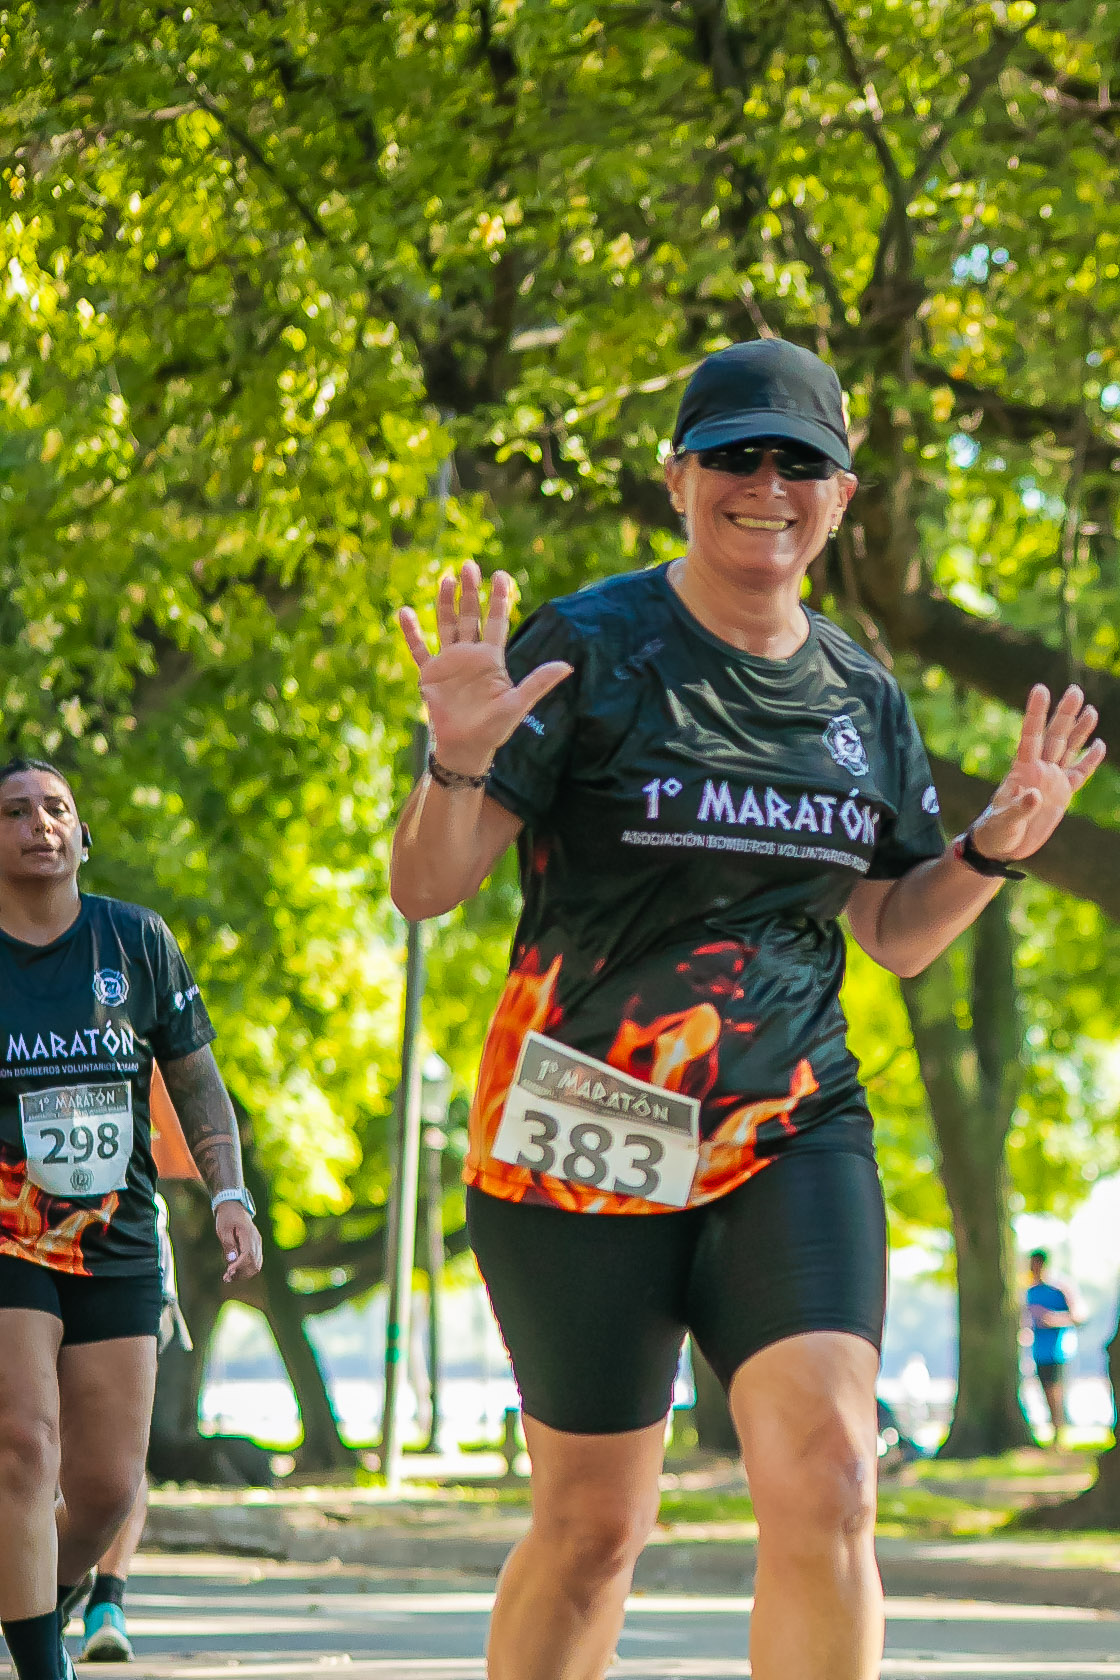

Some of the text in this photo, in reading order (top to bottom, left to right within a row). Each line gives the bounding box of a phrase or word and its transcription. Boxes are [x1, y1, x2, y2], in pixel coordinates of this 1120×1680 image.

[6, 1018, 135, 1062] MARATÓN
[55, 1088, 116, 1111] MARATÓN
[39, 1122, 120, 1166] 298
[516, 1108, 667, 1198] 383
